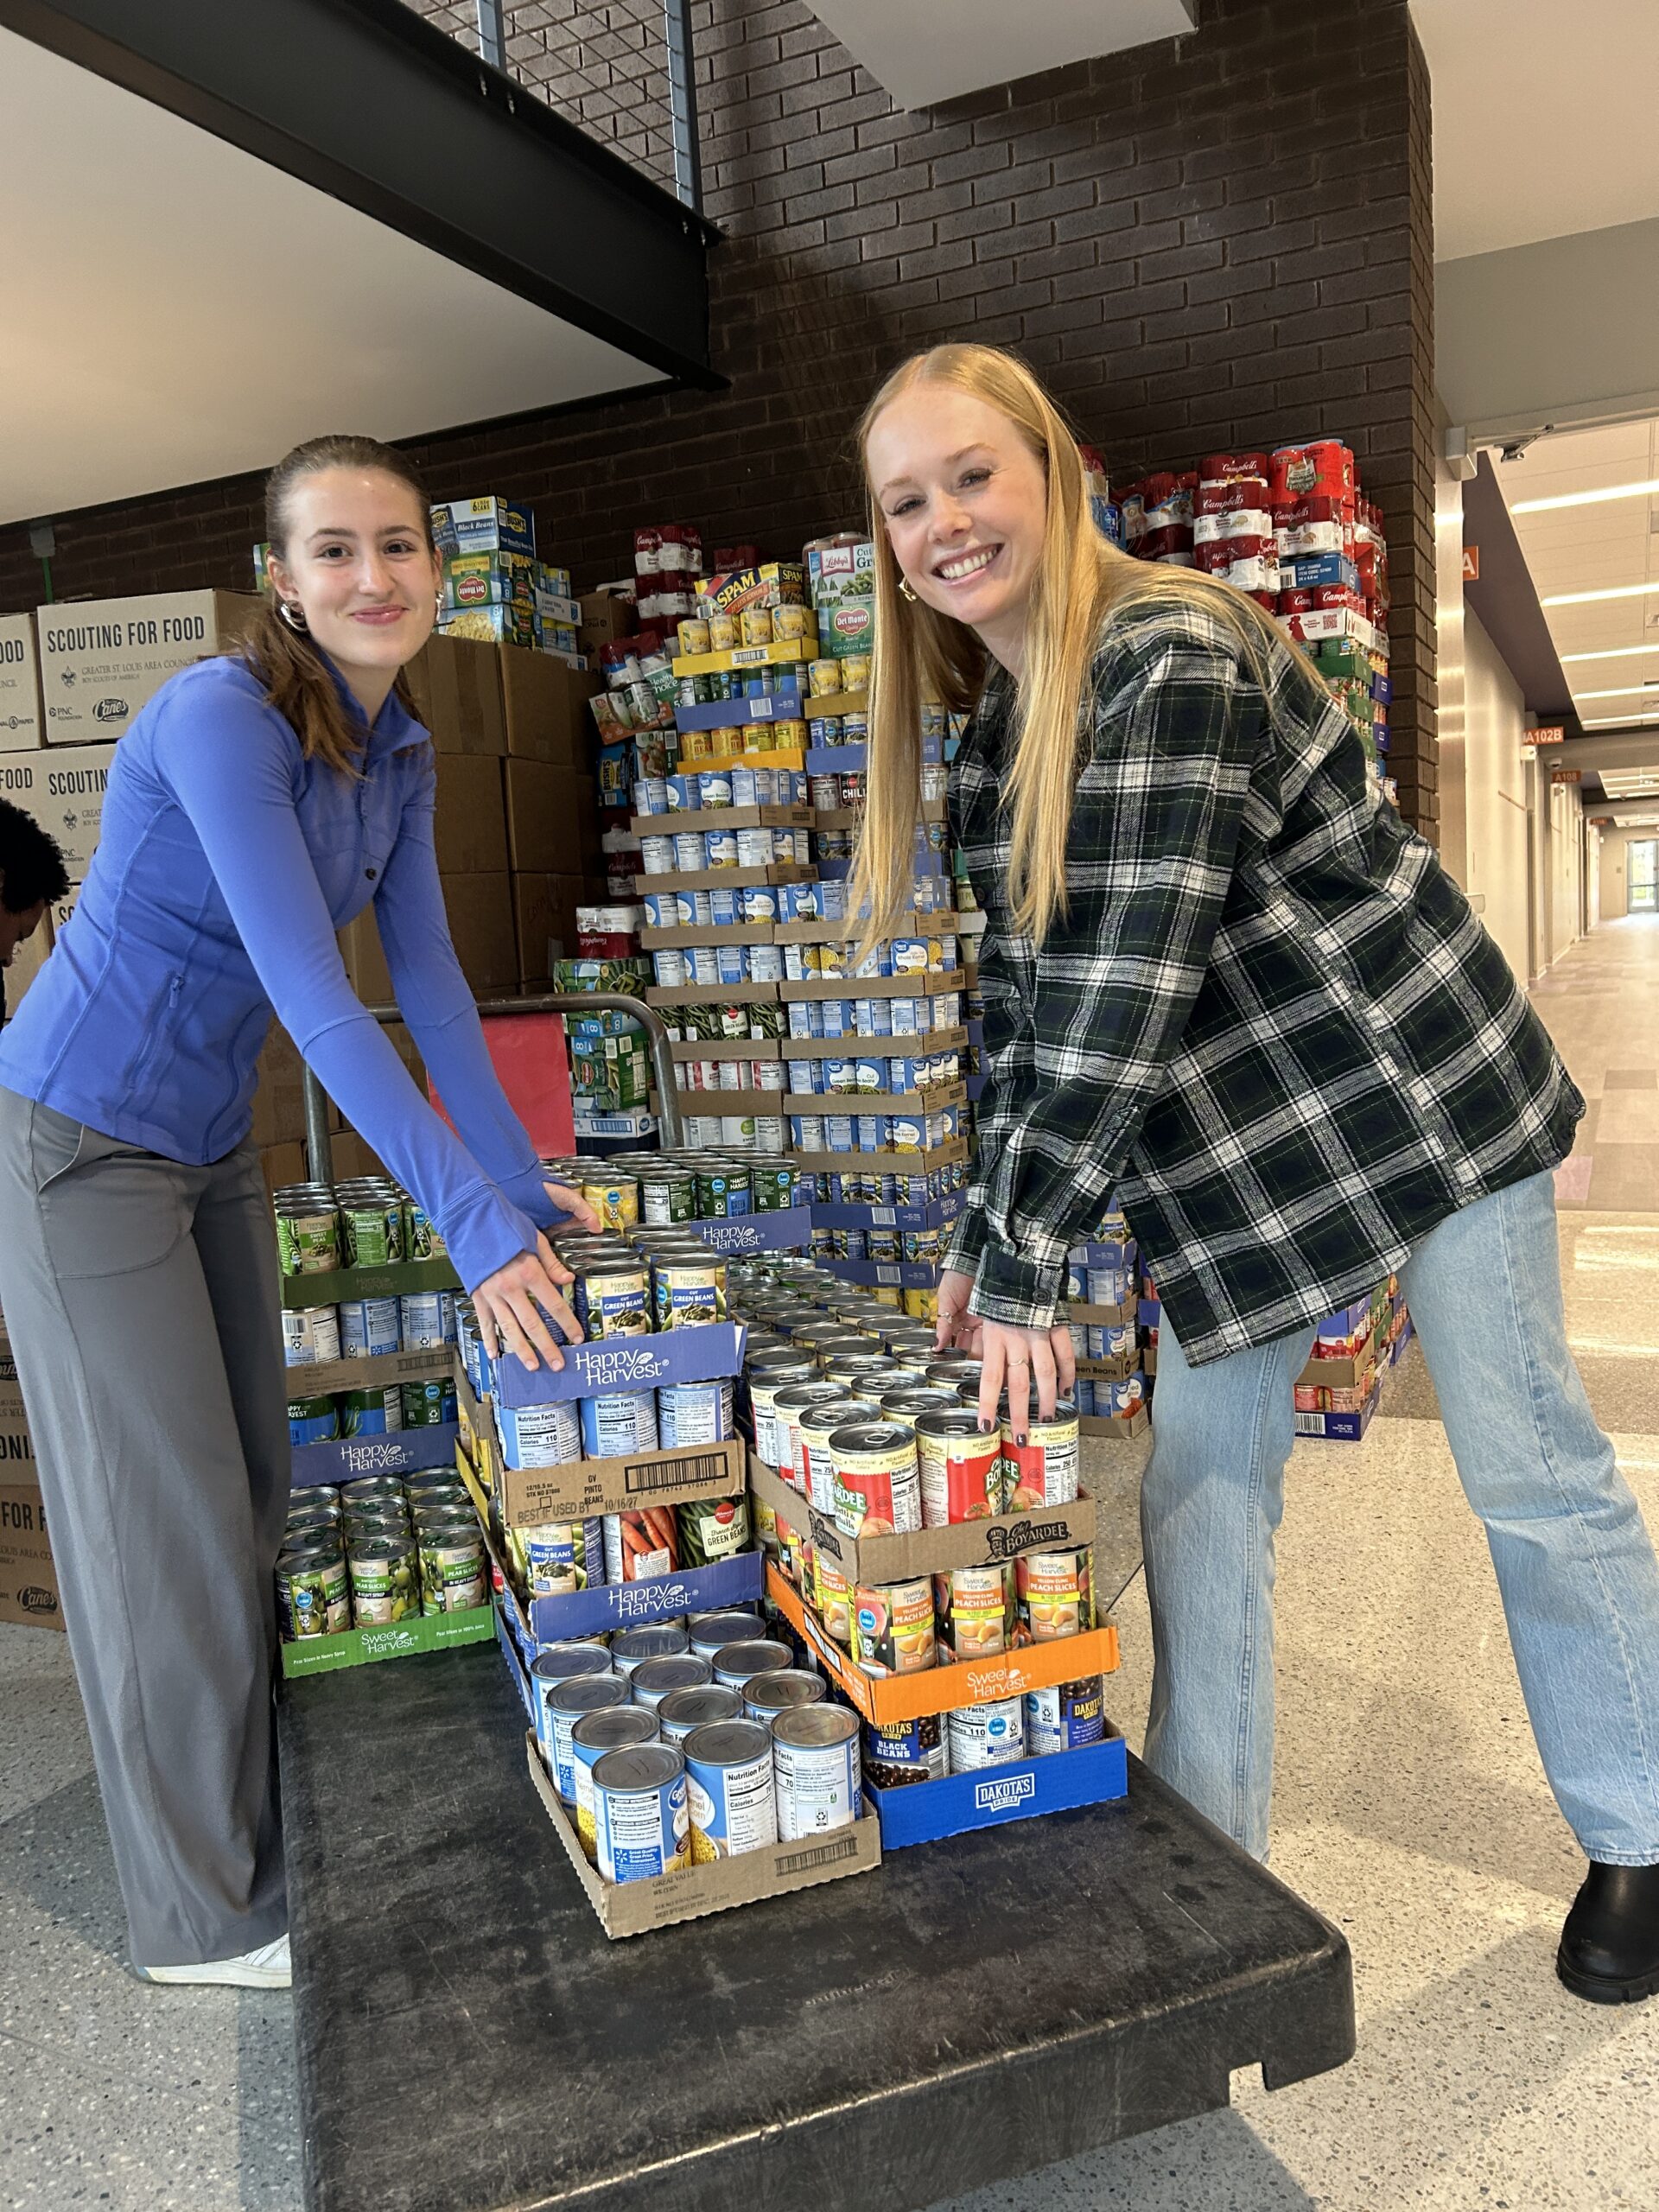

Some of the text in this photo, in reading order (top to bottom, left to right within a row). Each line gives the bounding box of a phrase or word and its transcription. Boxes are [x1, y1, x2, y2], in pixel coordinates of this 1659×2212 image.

[1223, 461, 1257, 474] Campbell's
[1204, 494, 1243, 512] Campbell's
[782, 569, 803, 582] SPAM
[717, 572, 756, 607] SPAM
[837, 614, 868, 626] Del Monte
[48, 616, 205, 652] SCOUTING FOR FOOD
[82, 665, 111, 675] GREATER
[123, 663, 143, 671] LOUIS
[144, 661, 162, 671] AREA
[57, 707, 73, 716] PNC
[48, 768, 108, 796] SCOUTIN
[60, 849, 76, 857] PNC
[703, 1225, 747, 1242] Happy
[710, 1234, 760, 1250] Harvest
[605, 1298, 644, 1310] GREEN BEANS
[695, 1294, 715, 1302] BEANS
[575, 1348, 639, 1373] Happy
[586, 1360, 663, 1386] Harvest
[340, 1443, 390, 1460] Happy
[349, 1451, 409, 1471] Harvest
[891, 1465, 911, 1477] Nutrition
[588, 1474, 597, 1484] GV
[585, 1484, 601, 1494] PINTO
[585, 1495, 603, 1504] BEANS
[2, 1502, 33, 1530] FOR
[518, 1497, 638, 1523] BEST IF USED BY 10/16/27
[708, 1525, 746, 1546] GREEN BEANS
[1012, 1521, 1031, 1538] Chef
[1007, 1522, 1067, 1553] BOYARDEE
[1031, 1582, 1077, 1592] PEACH SLICES
[608, 1583, 671, 1607] Happy
[980, 1597, 1001, 1605] SLICES
[618, 1593, 691, 1618] Harvest
[895, 1612, 918, 1624] PEACH
[362, 1630, 398, 1645] Sweet
[367, 1637, 415, 1654] Harvest
[967, 1667, 1010, 1688] Sweet
[973, 1676, 1027, 1700] Harvest
[878, 1740, 907, 1750] BLACK
[779, 1751, 793, 1762] Facts
[876, 1748, 911, 1758] BEANS
[728, 1769, 757, 1781] Nutrition
[785, 1779, 793, 1788] 70
[980, 1777, 1031, 1802] DAKOTA'S
[730, 1798, 753, 1808] Calories
[995, 1796, 1017, 1806] PRIDE
